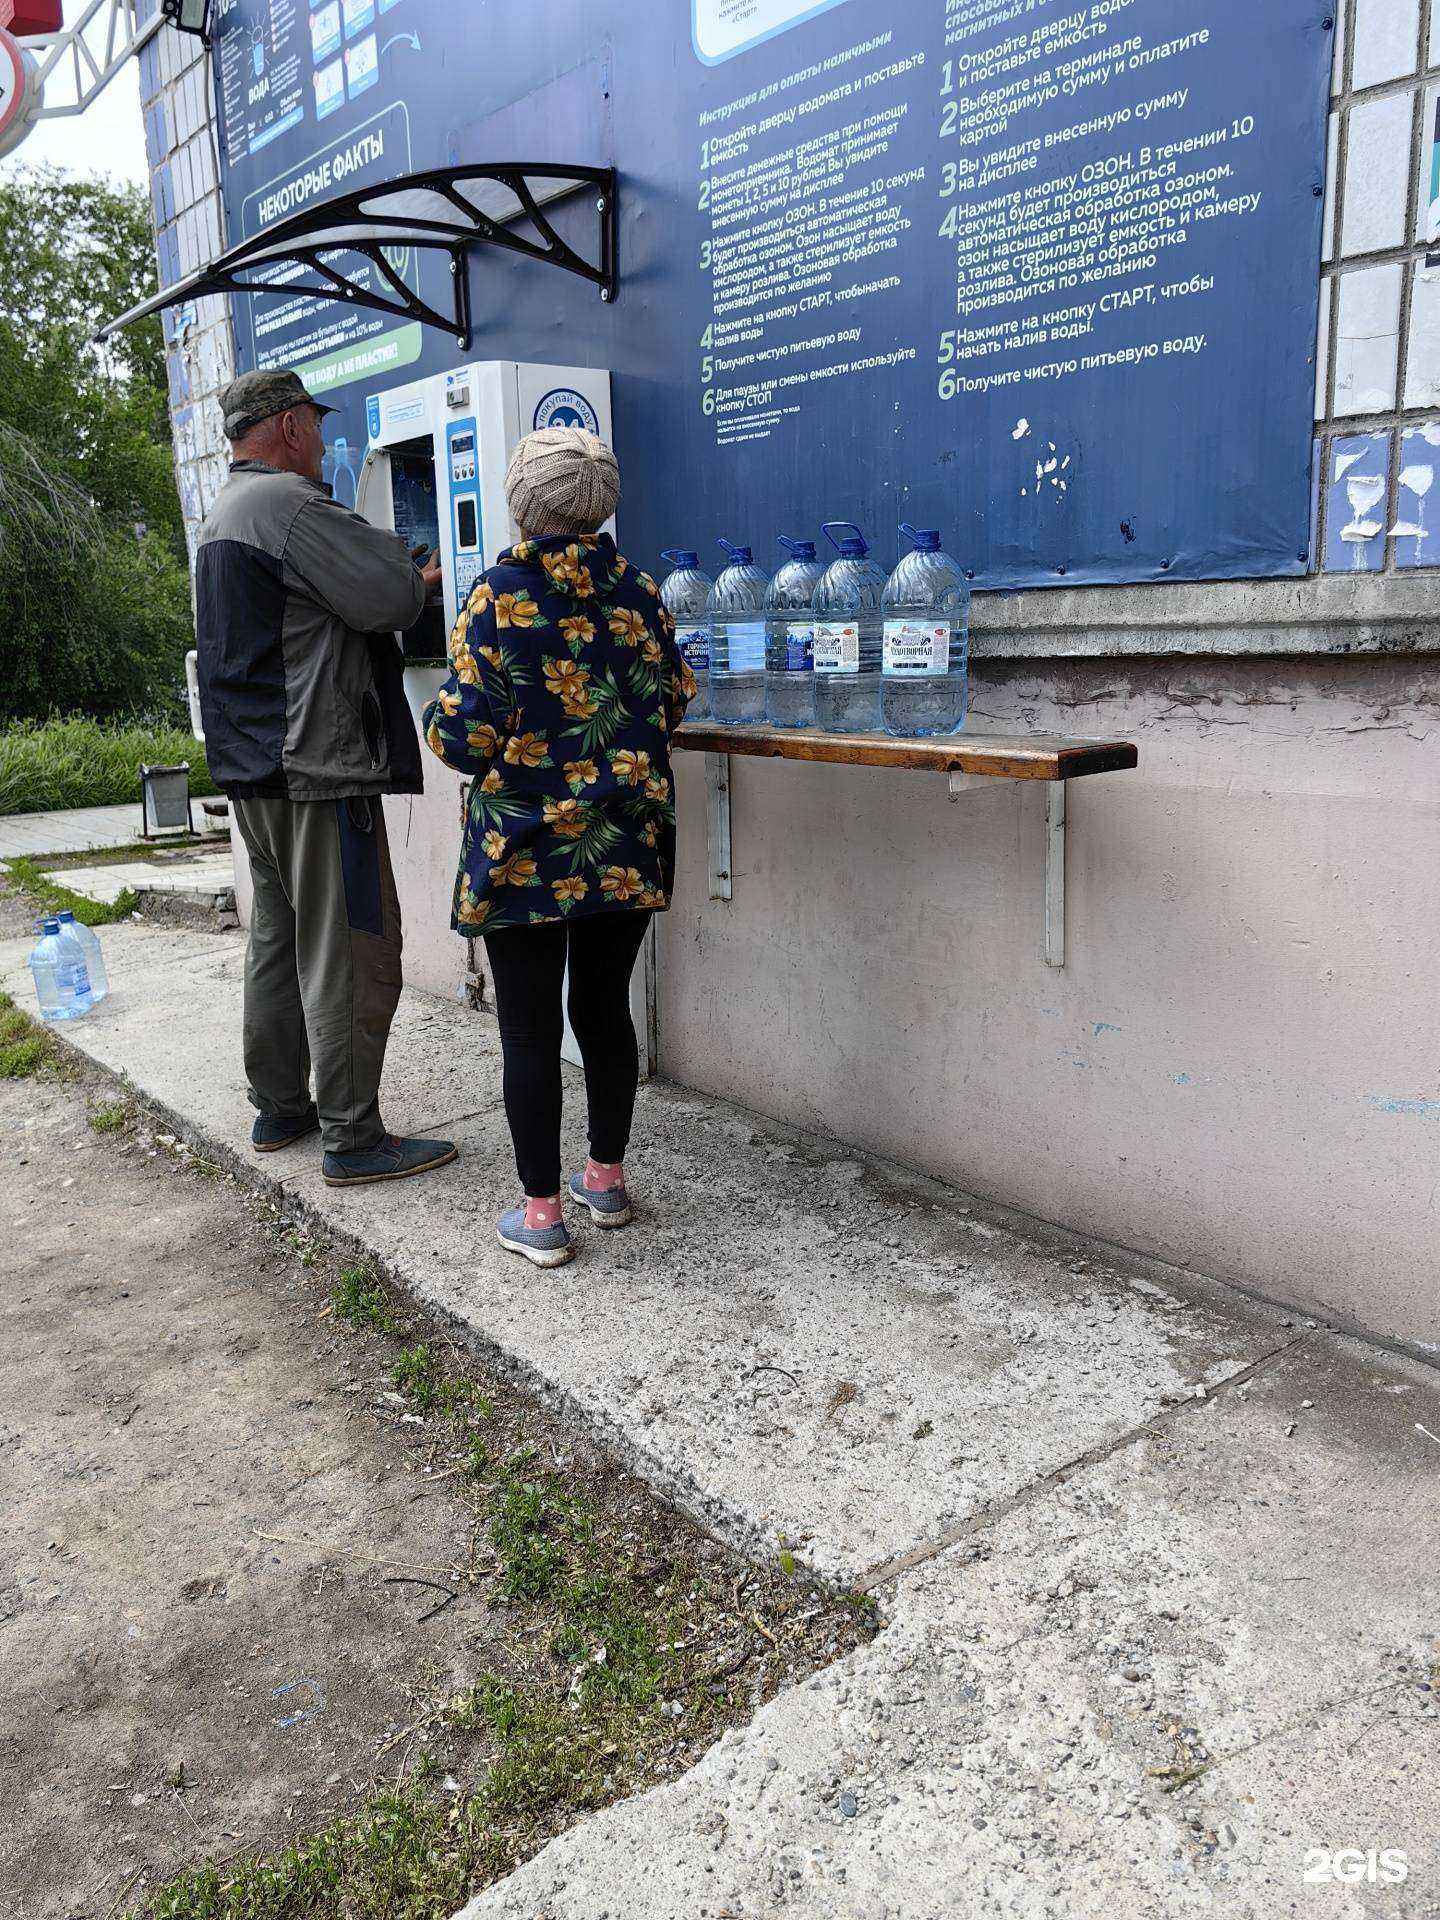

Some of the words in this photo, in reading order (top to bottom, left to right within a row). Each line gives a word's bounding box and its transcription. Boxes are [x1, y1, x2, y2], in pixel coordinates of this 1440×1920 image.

[959, 35, 1027, 71] Откройте
[1030, 10, 1087, 47] дверцу
[971, 46, 1041, 84] поставьте
[1044, 21, 1107, 55] емкость
[248, 77, 270, 105] ВОДА
[699, 92, 758, 126] Инструкция
[758, 82, 779, 103] для
[780, 62, 821, 90] оплаты
[823, 30, 893, 71] наличными
[939, 60, 953, 96] 1
[960, 78, 1030, 114] Выберите
[1034, 70, 1051, 88] на
[1055, 36, 1142, 79] терминале
[960, 85, 1058, 131] необходимую
[1062, 65, 1111, 95] сумму
[1129, 28, 1210, 69] оплатите
[710, 124, 757, 152] Откройте
[758, 107, 797, 134] дверцу
[799, 83, 852, 115] водомата
[864, 52, 925, 88] поставьте
[939, 101, 958, 138] 2
[700, 140, 710, 170] 1
[711, 169, 745, 189] Внесите
[747, 149, 794, 176] денежные
[795, 130, 839, 157] средства
[863, 103, 907, 128] помощи
[711, 142, 749, 166] емкость
[796, 146, 839, 169] Водомат
[841, 122, 899, 152] принимает
[959, 158, 979, 176] Вы
[982, 138, 1041, 170] увидите
[1044, 108, 1131, 148] внесенную
[1135, 88, 1188, 119] сумму
[960, 116, 1007, 146] картой
[258, 161, 331, 225] НЕКОТОРЫЕ
[333, 129, 384, 181] ФАКТЫ
[711, 196, 743, 215] монеты
[791, 163, 826, 189] рублей
[828, 158, 842, 172] Вы
[845, 141, 888, 170] увидите
[939, 162, 957, 197] 3
[958, 191, 1021, 220] Нажмите
[1025, 173, 1077, 200] кнопку
[1081, 152, 1135, 183] ОЗОН.
[1140, 147, 1151, 166] В
[1155, 128, 1226, 161] течении
[1231, 115, 1254, 139] 10
[959, 177, 975, 191] на
[978, 156, 1037, 188] дисплее
[698, 180, 710, 210] 2
[711, 205, 758, 229] внесенную
[760, 194, 788, 212] сумму
[803, 173, 844, 198] дисплее
[713, 228, 751, 249] Нажмите
[752, 216, 783, 236] кнопку
[819, 198, 827, 213] В
[829, 186, 869, 208] течение
[871, 178, 884, 194] 10
[886, 166, 925, 189] секунд
[958, 211, 1006, 236] секунд
[1009, 203, 1050, 222] будет
[1054, 161, 1176, 209] производиться
[958, 209, 1071, 251] автоматическая
[1074, 183, 1160, 219] обработка
[1165, 163, 1234, 193] озоном.
[712, 247, 735, 264] будет
[738, 223, 805, 253] производиться
[807, 195, 887, 230] автоматическая
[713, 253, 757, 276] обработка
[796, 232, 821, 248] Озон
[823, 214, 873, 240] насыщает
[875, 205, 902, 222] воду
[776, 252, 804, 269] также
[806, 231, 866, 260] стерилизует
[868, 217, 911, 240] емкость
[938, 206, 957, 239] 4
[957, 249, 989, 267] озон
[993, 226, 1066, 257] насыщает
[1069, 215, 1107, 238] воду
[1110, 186, 1220, 226] кислородом,
[969, 258, 1009, 279] также
[1013, 232, 1105, 268] стерилизует
[1109, 215, 1175, 243] емкость
[1195, 191, 1261, 221] камеру
[700, 240, 711, 269] 3
[720, 281, 750, 300] камеру
[793, 254, 840, 277] Озоновая
[842, 236, 897, 263] обработка
[957, 273, 1016, 303] розлива.
[1021, 252, 1094, 282] Озоновая
[1098, 229, 1187, 262] обработка
[713, 288, 773, 316] производится
[788, 271, 832, 294] желанию
[957, 279, 1055, 316] производится
[1059, 273, 1077, 290] по
[1080, 254, 1156, 284] желанию
[957, 321, 1019, 345] Нажмите
[1022, 316, 1039, 330] на
[1042, 302, 1096, 325] кнопку
[1100, 284, 1156, 312] СТАРТ,
[1161, 273, 1214, 298] чтобы
[700, 323, 714, 350] 4
[714, 316, 752, 335] Нажмите
[766, 303, 798, 320] кнопку
[714, 332, 739, 348] налив
[741, 326, 763, 341] воды
[957, 340, 1001, 360] начать
[1005, 330, 1047, 350] налив
[1051, 321, 1094, 339] воды.
[701, 355, 713, 383] 5
[715, 352, 755, 372] Получите
[756, 345, 788, 361] чистую
[790, 333, 835, 354] питьевую
[837, 327, 861, 342] воду
[938, 330, 956, 363] 5
[957, 370, 1021, 393] Получите
[1024, 360, 1077, 379] чистую
[1081, 344, 1158, 370] питьевую
[1163, 334, 1207, 354] воду.
[715, 388, 732, 402] Для
[733, 383, 760, 397] паузы
[761, 377, 777, 391] или
[779, 373, 808, 388] смены
[810, 363, 848, 381] емкости
[851, 347, 916, 373] используйте
[938, 367, 956, 400] 6
[539, 394, 573, 422] покупай
[575, 400, 594, 426] воду
[702, 388, 714, 416] 6
[716, 400, 745, 413] кнопку
[746, 390, 772, 407] СТОП
